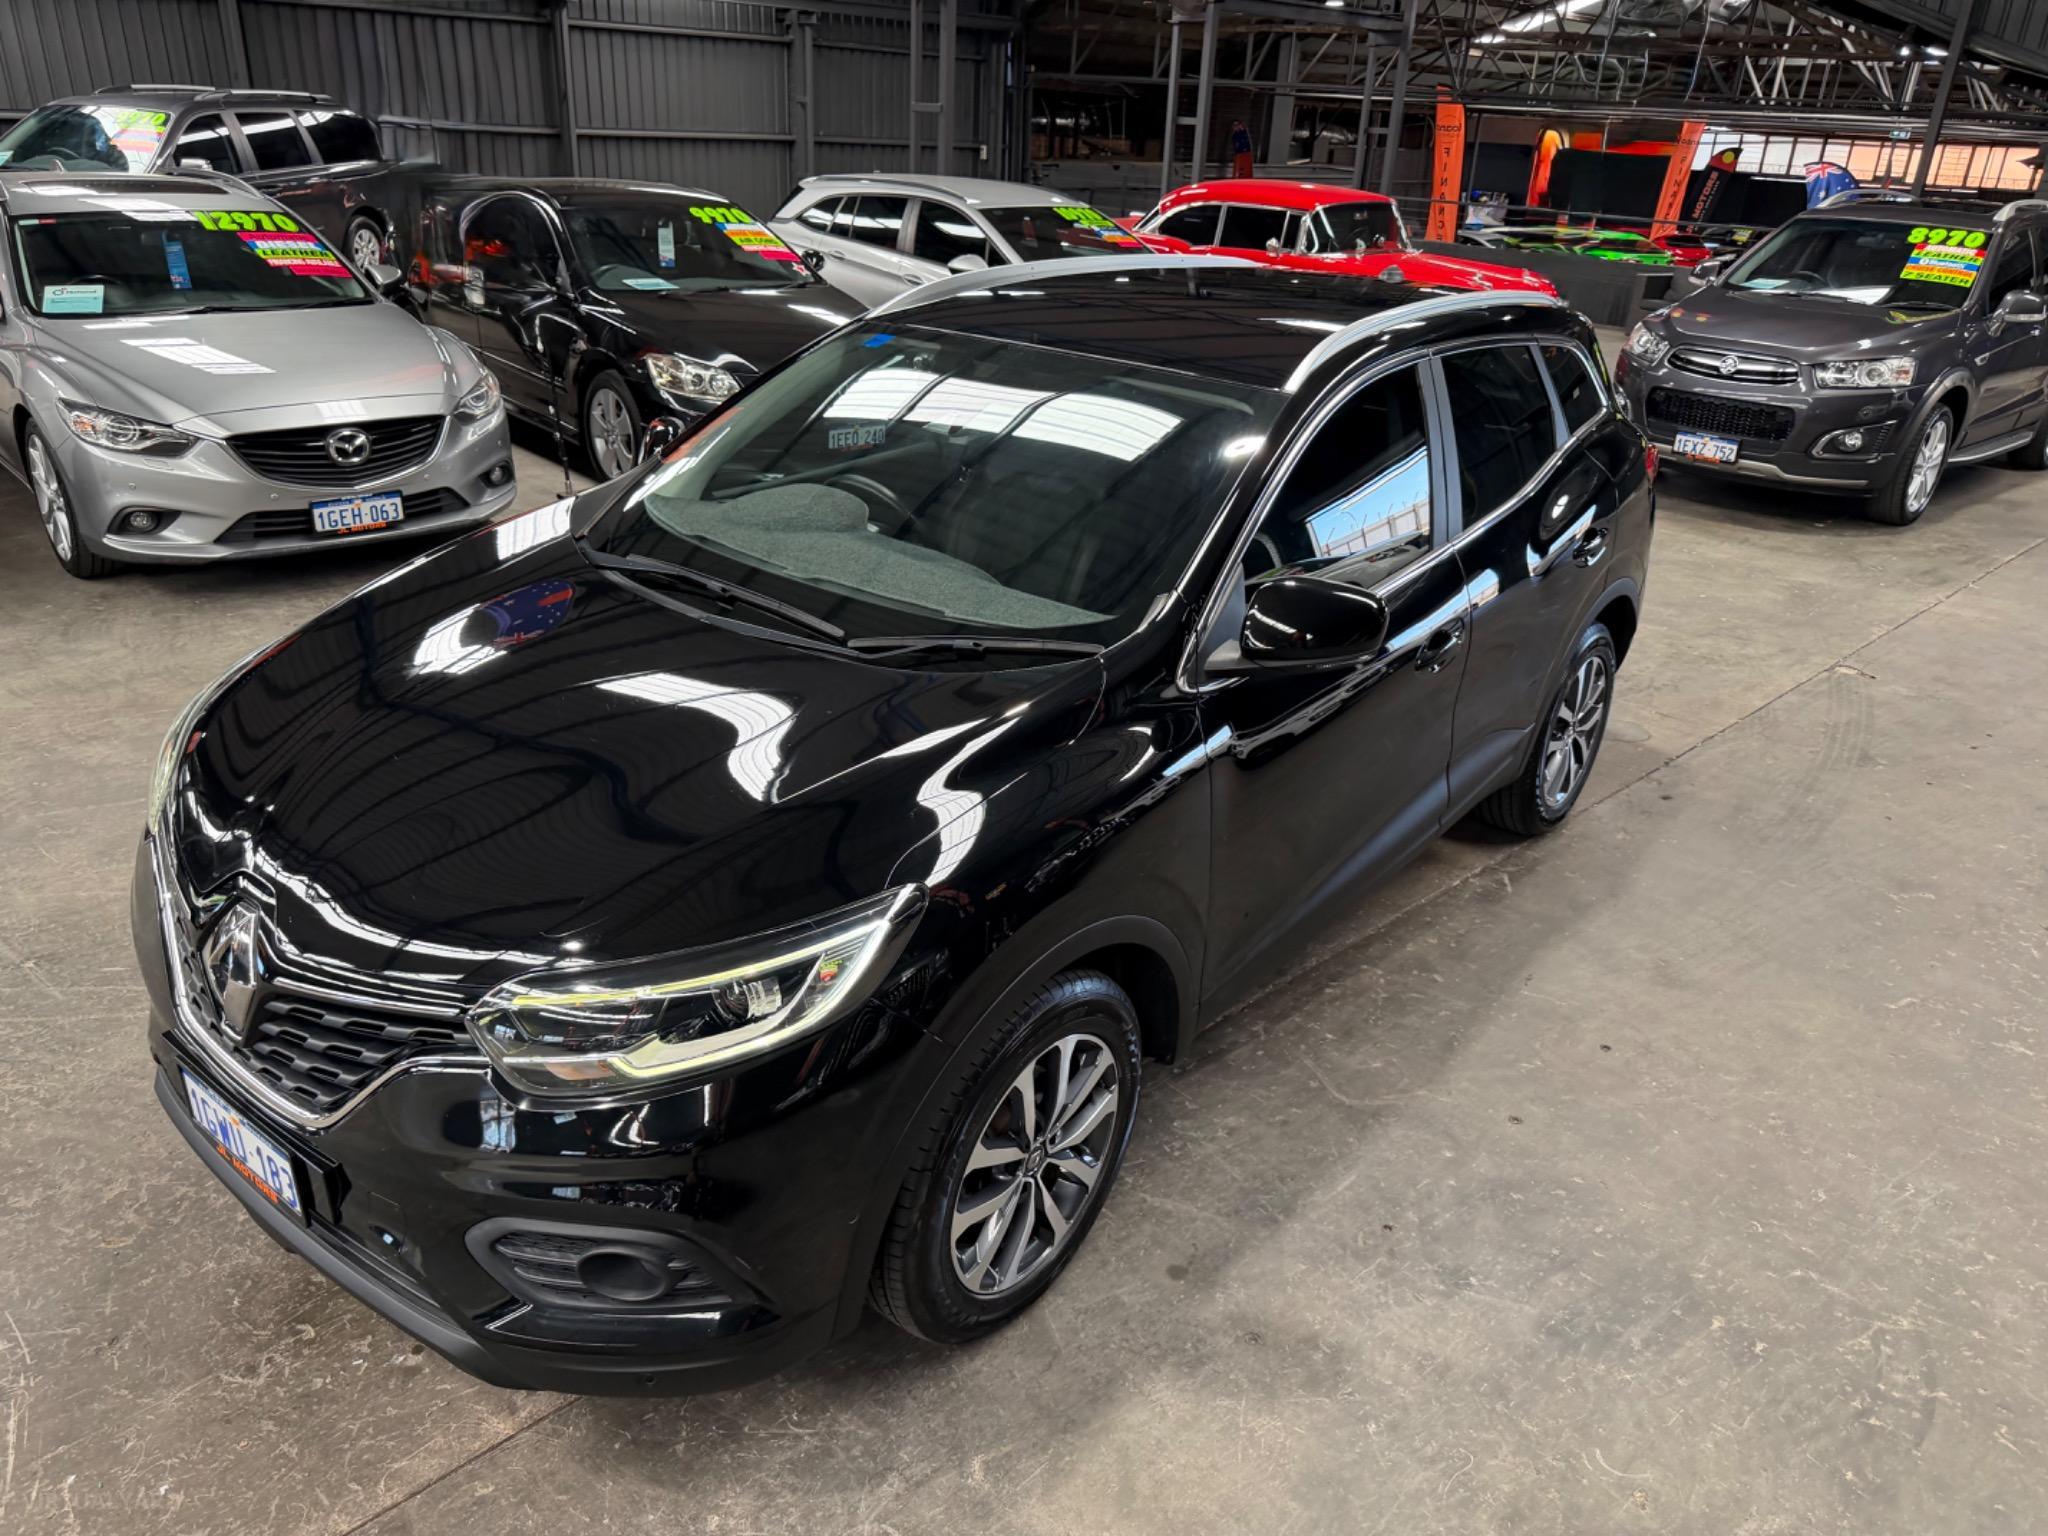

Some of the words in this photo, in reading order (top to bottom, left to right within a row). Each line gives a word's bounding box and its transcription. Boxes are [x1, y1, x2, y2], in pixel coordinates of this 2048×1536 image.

[193, 211, 299, 232] 12970
[689, 207, 753, 224] 9970
[1907, 227, 1986, 248] 8970
[262, 249, 333, 257] LEATHER
[1914, 250, 1981, 264] LEATHER
[1916, 272, 1969, 285] SEATER
